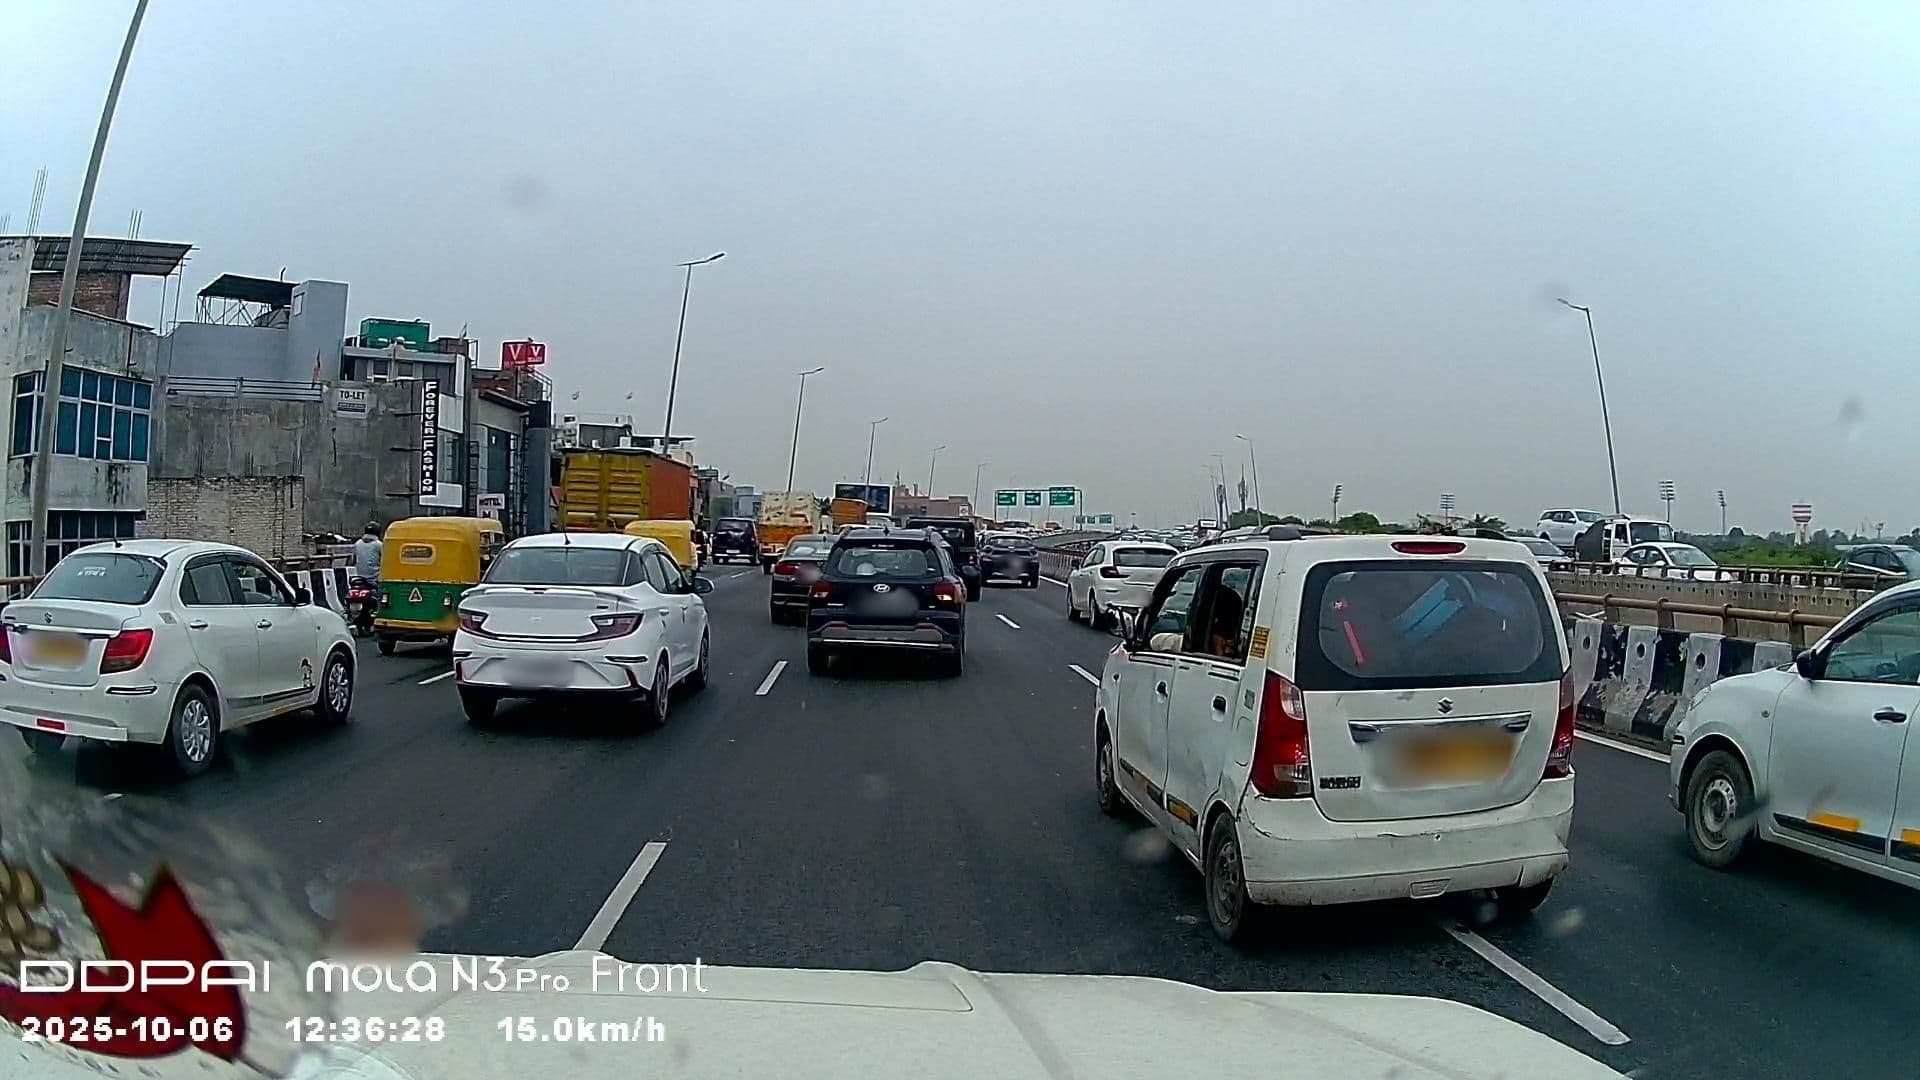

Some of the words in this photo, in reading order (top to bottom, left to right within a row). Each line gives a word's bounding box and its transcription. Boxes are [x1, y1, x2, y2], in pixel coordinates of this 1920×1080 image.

[340, 390, 366, 400] TO-LET
[425, 381, 438, 434] FOREVER
[422, 439, 435, 493] FASHION
